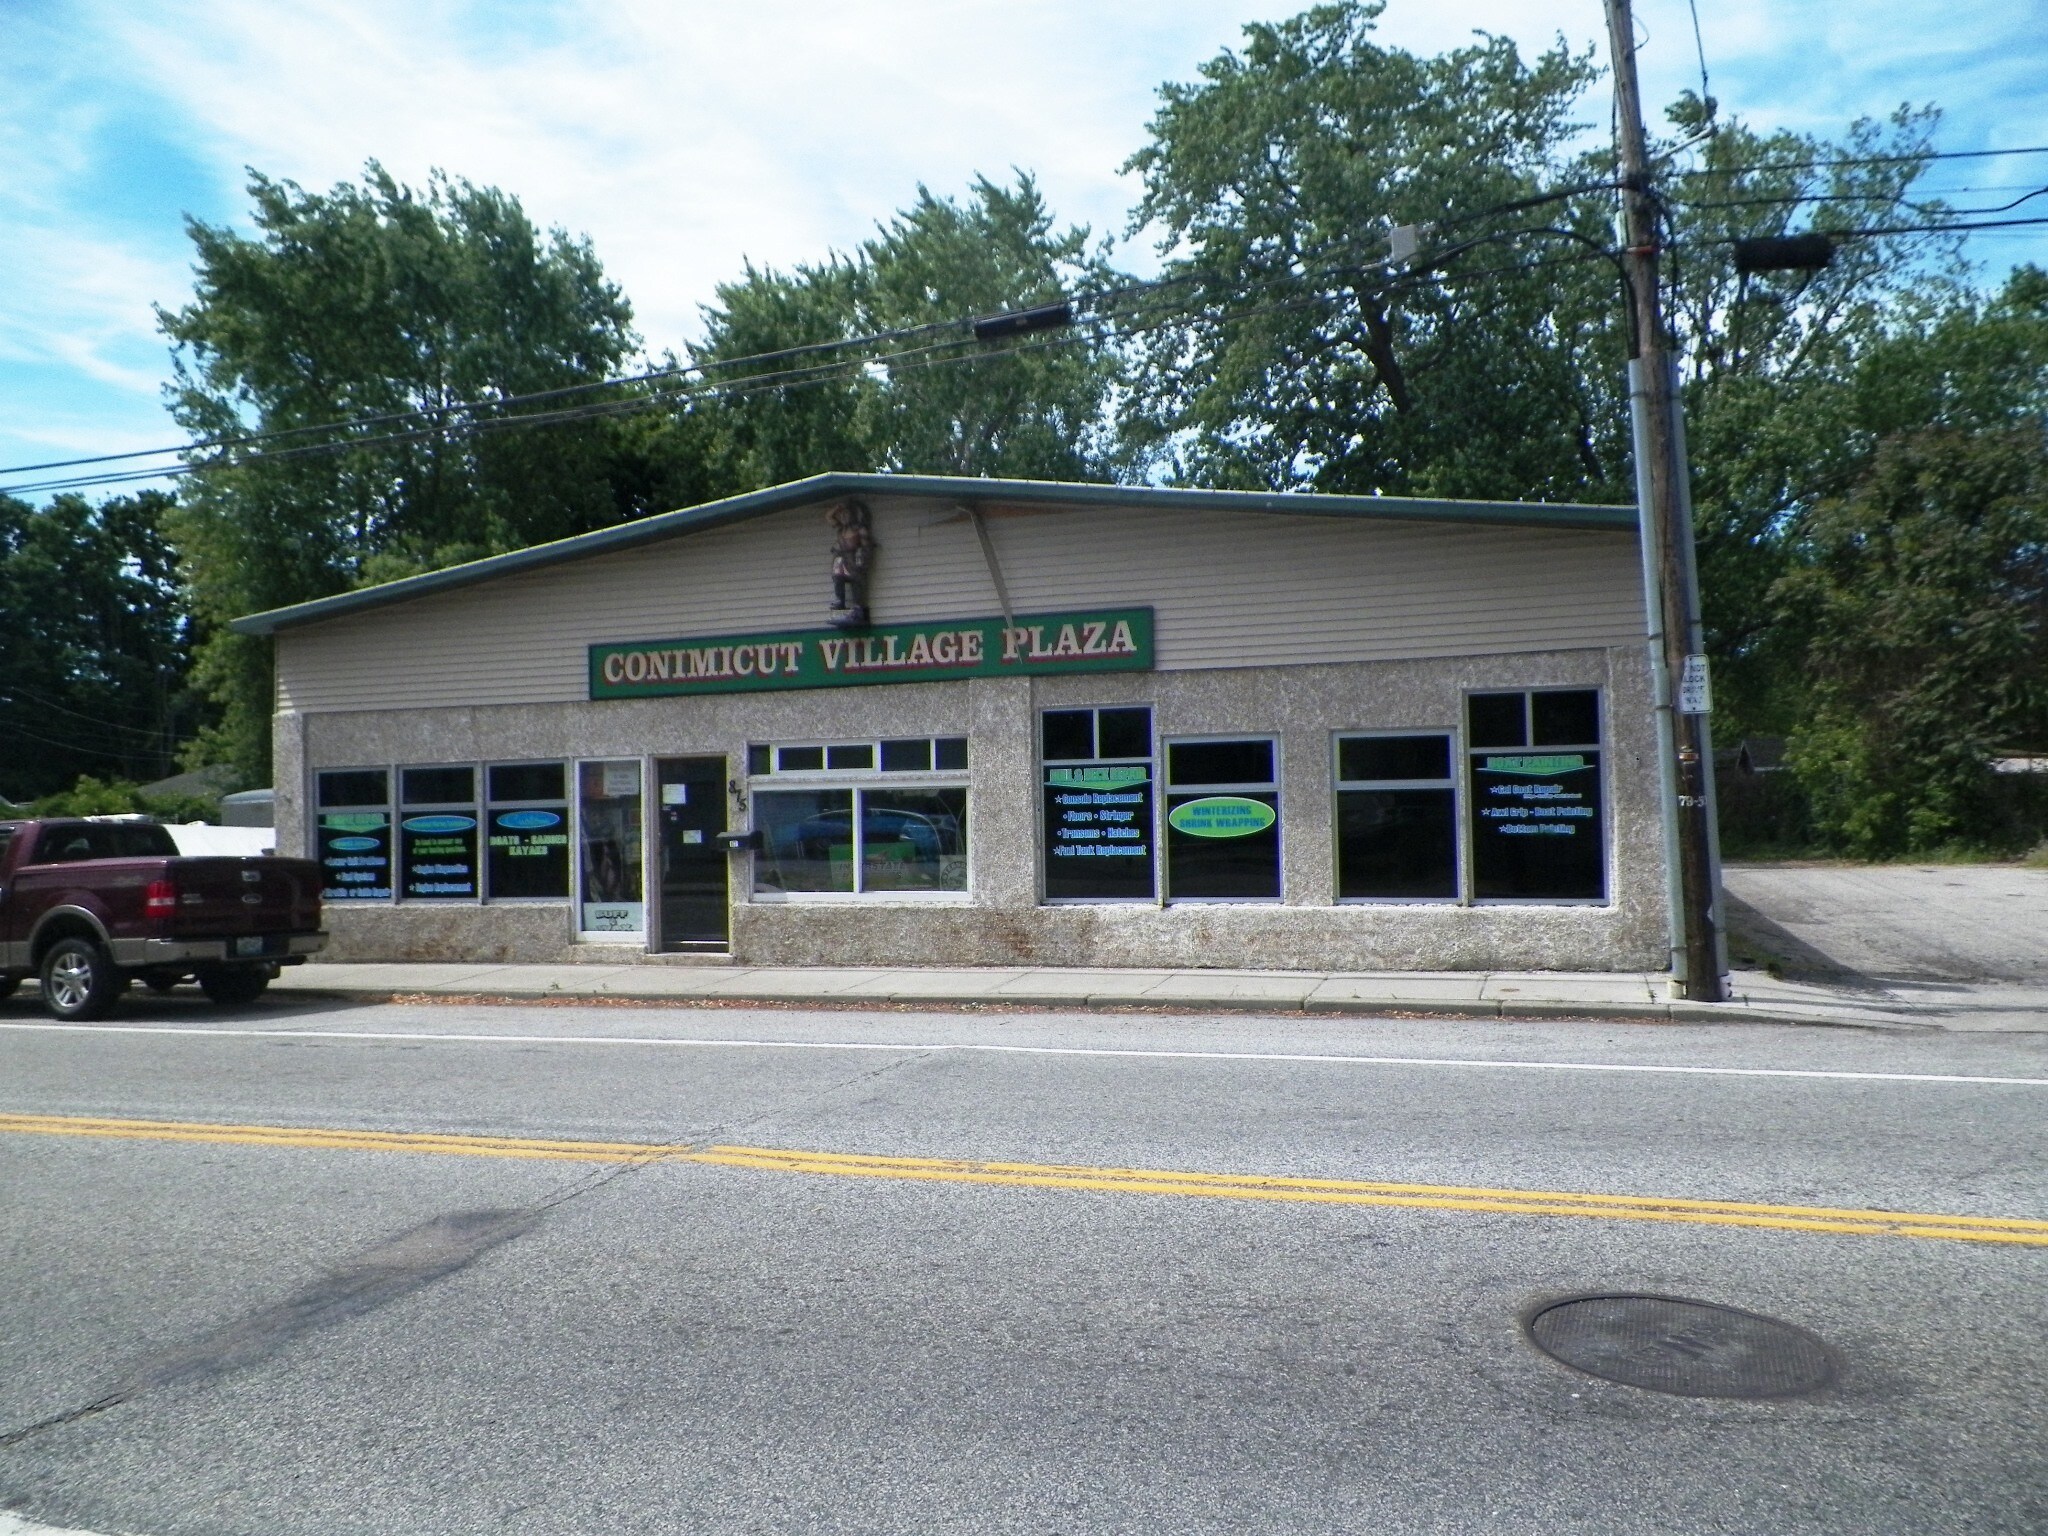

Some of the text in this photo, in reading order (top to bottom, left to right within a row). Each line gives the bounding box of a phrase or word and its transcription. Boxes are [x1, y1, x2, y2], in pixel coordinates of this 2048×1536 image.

[603, 620, 1137, 683] CONIMICUT VILLAGE PLAZA
[1683, 675, 1705, 683] LOCK
[1061, 792, 1144, 804] Console Replacement
[1067, 810, 1134, 822] Floors Stringer
[1192, 805, 1252, 816] WINTERIZING
[1179, 817, 1266, 828] SHRINK WRAPPING
[1061, 827, 1140, 838] Transoms Hatches
[1095, 845, 1147, 856] Replacement
